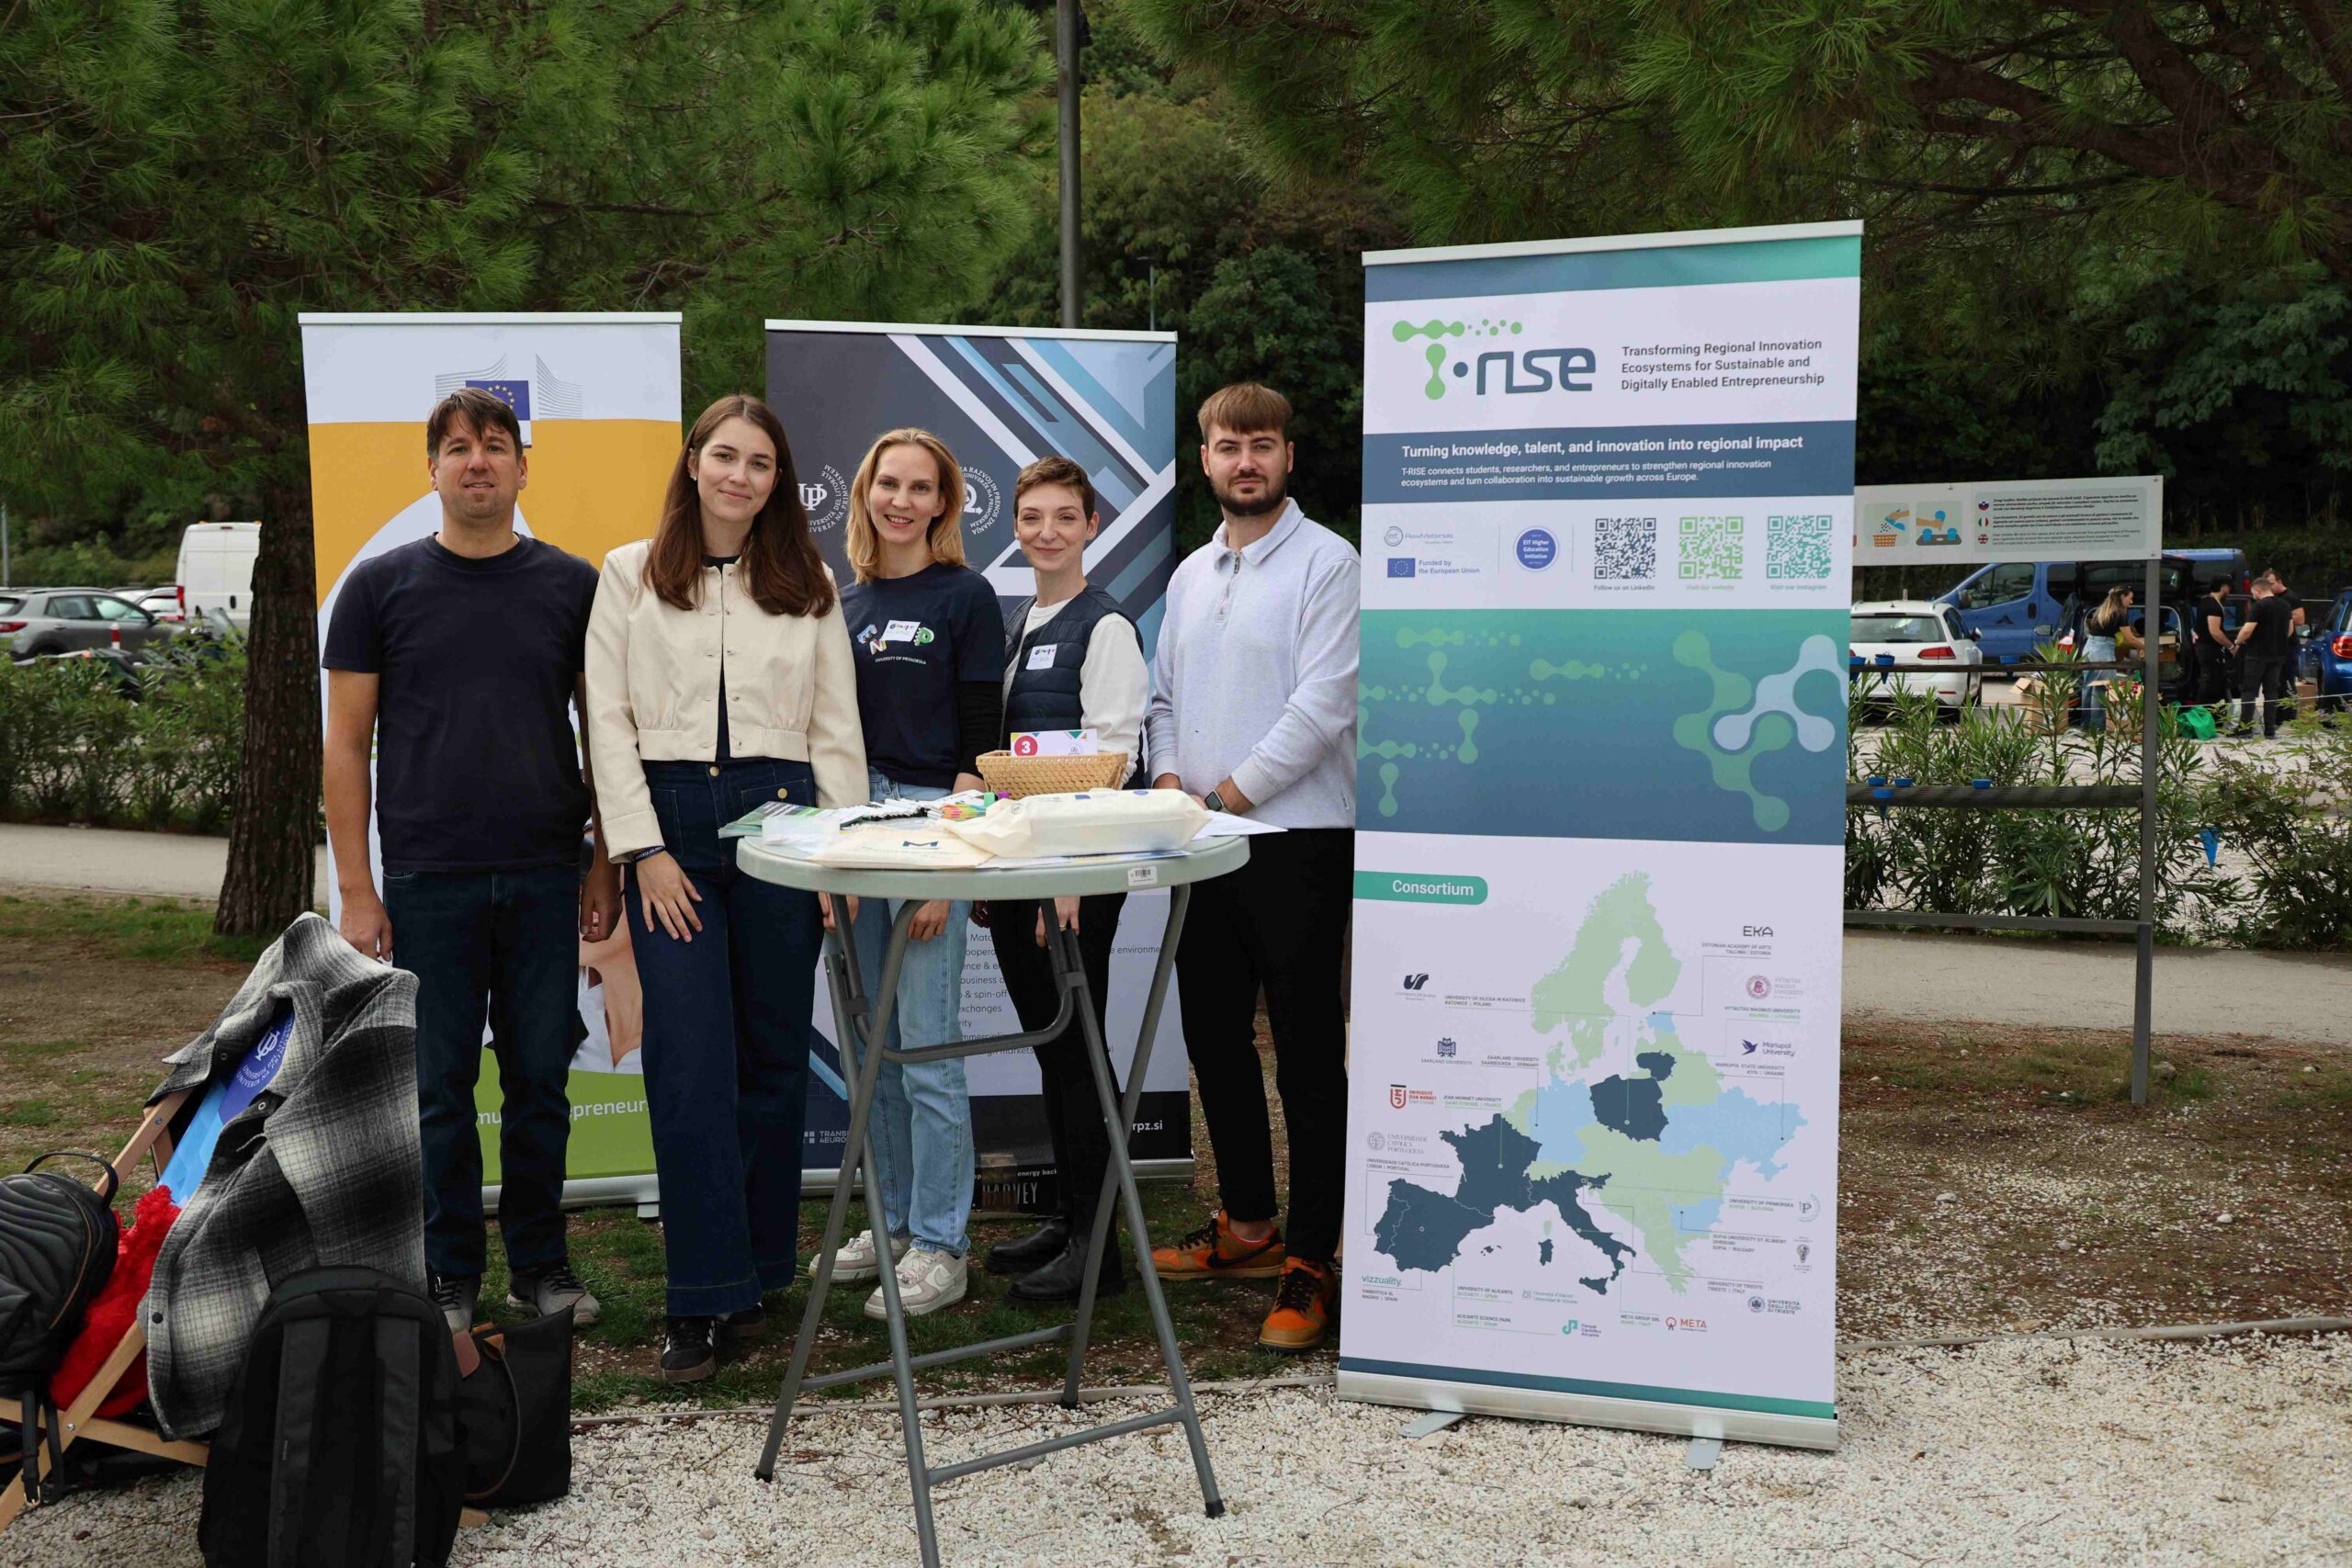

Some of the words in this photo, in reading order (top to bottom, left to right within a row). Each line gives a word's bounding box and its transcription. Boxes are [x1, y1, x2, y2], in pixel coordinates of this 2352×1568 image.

[1623, 345, 1700, 356] Transforming
[1704, 342, 1756, 355] Regional
[1758, 340, 1822, 351] Innovation
[1622, 362, 1691, 375] Ecosystems
[1695, 360, 1712, 371] for
[1714, 358, 1784, 369] Sustainable
[1788, 356, 1810, 367] and
[1622, 378, 1668, 391] Digitally
[1671, 377, 1718, 389] Enabled
[1722, 373, 1825, 388] Entrepreneurship
[1402, 445, 1449, 459] Turning
[1452, 443, 1521, 457] knowledge,
[1525, 441, 1565, 455] talent,
[1569, 441, 1593, 452] and
[1597, 439, 1665, 452] innovation
[1668, 438, 1694, 450] into
[1698, 437, 1752, 453] regional
[1757, 435, 1804, 451] impact
[1402, 467, 1426, 476] T-RISE
[1428, 467, 1464, 475] connects
[1466, 465, 1501, 474] students,
[1503, 464, 1552, 474] researchers,
[1555, 463, 1570, 472] and
[1572, 463, 1629, 472] entrepreneurs
[1643, 461, 1687, 472] strengthen
[1690, 460, 1724, 470] regional
[1726, 459, 1771, 468] innovation
[1401, 478, 1448, 488] ecosystems
[1450, 477, 1464, 485] and
[1484, 476, 1535, 485] collaboration
[1538, 475, 1554, 483] into
[1555, 474, 1603, 483] sustainable
[1605, 474, 1634, 483] growth
[1667, 472, 1699, 482] Europe.
[1444, 559, 1452, 568] by
[1022, 740, 1031, 754] 3
[1393, 880, 1474, 897] Consortium
[1742, 926, 1773, 937] EKA
[570, 1100, 649, 1121] preneur
[1132, 1121, 1163, 1132] rpz.si
[1362, 1275, 1402, 1287] vizzuality.
[1679, 1319, 1707, 1328] META
